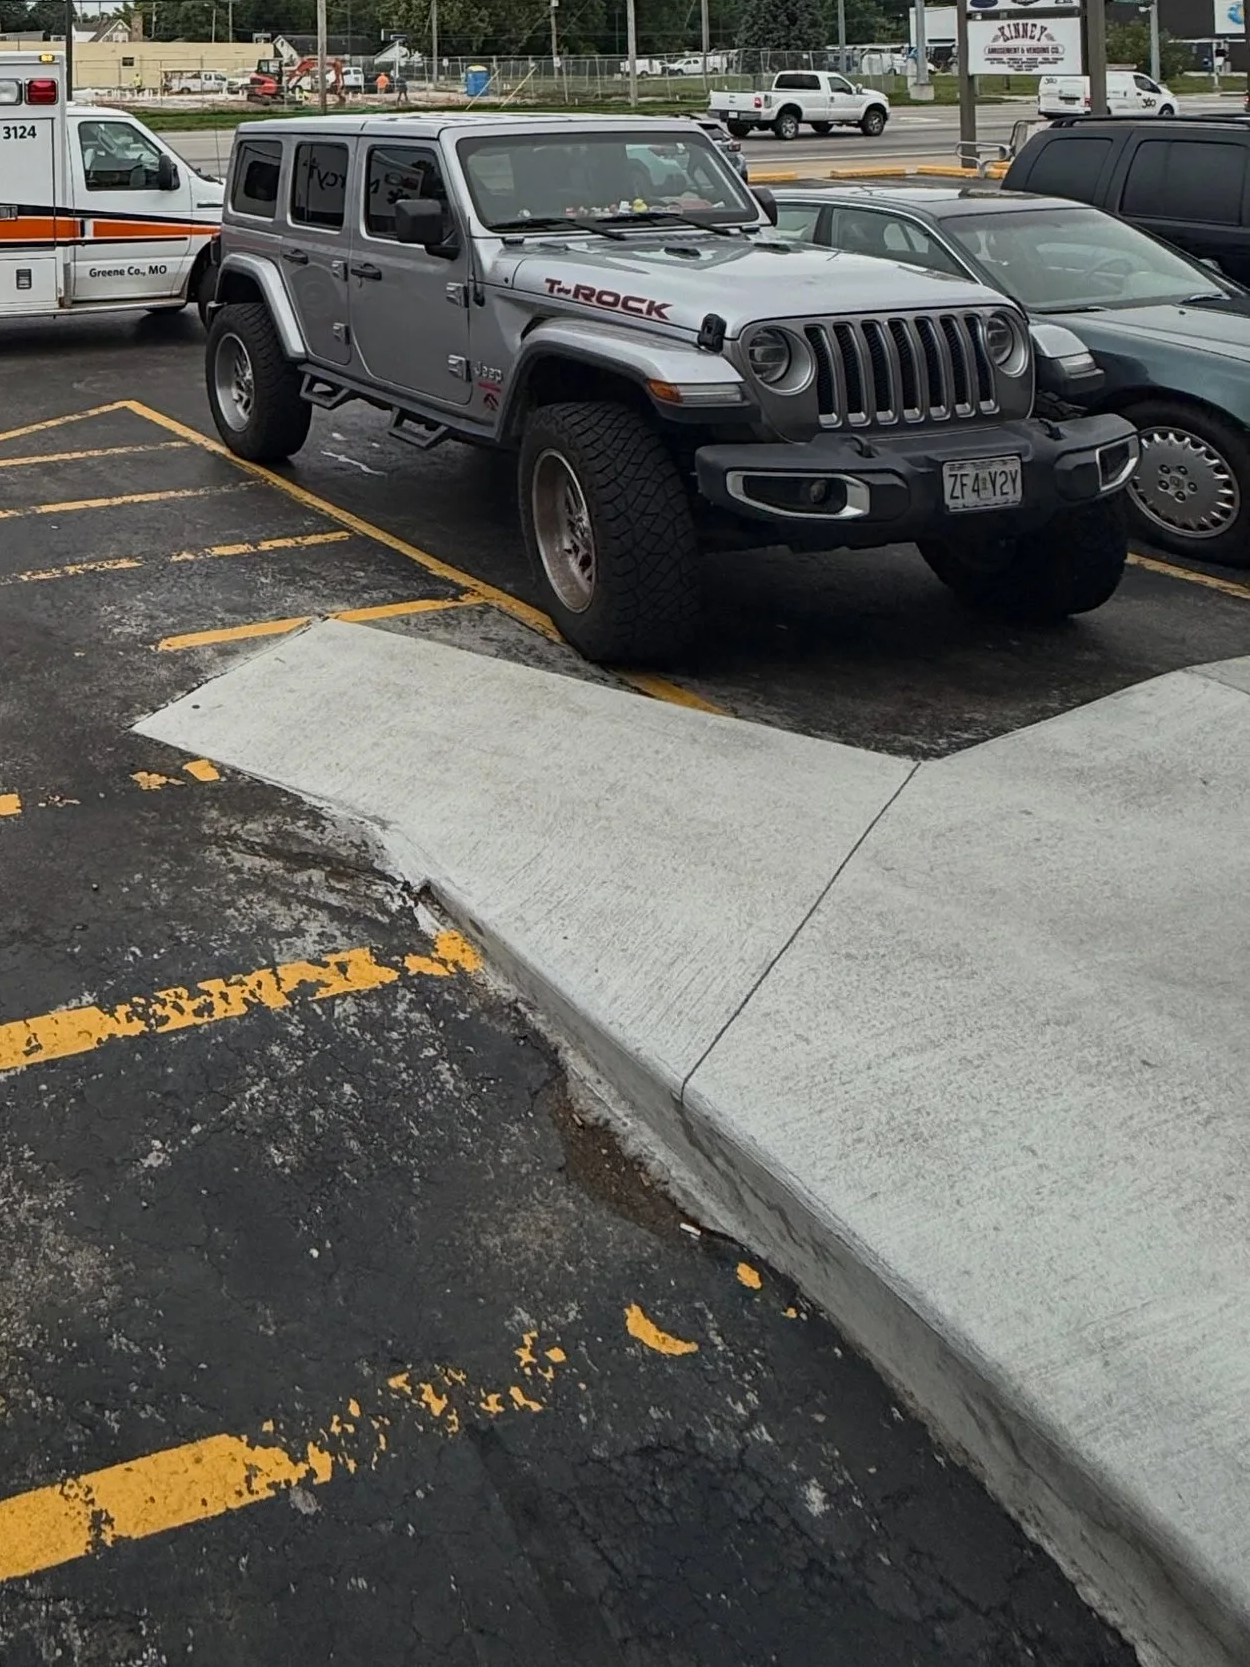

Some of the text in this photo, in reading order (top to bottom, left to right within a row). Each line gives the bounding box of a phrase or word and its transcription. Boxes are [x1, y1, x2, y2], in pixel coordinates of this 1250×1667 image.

[997, 22, 1049, 43] KINNEY
[2, 125, 38, 140] 3124
[88, 267, 125, 278] Greene
[148, 264, 168, 276] MO
[473, 360, 502, 382] Jeep
[948, 468, 1019, 501] ZF4 Y2Y
